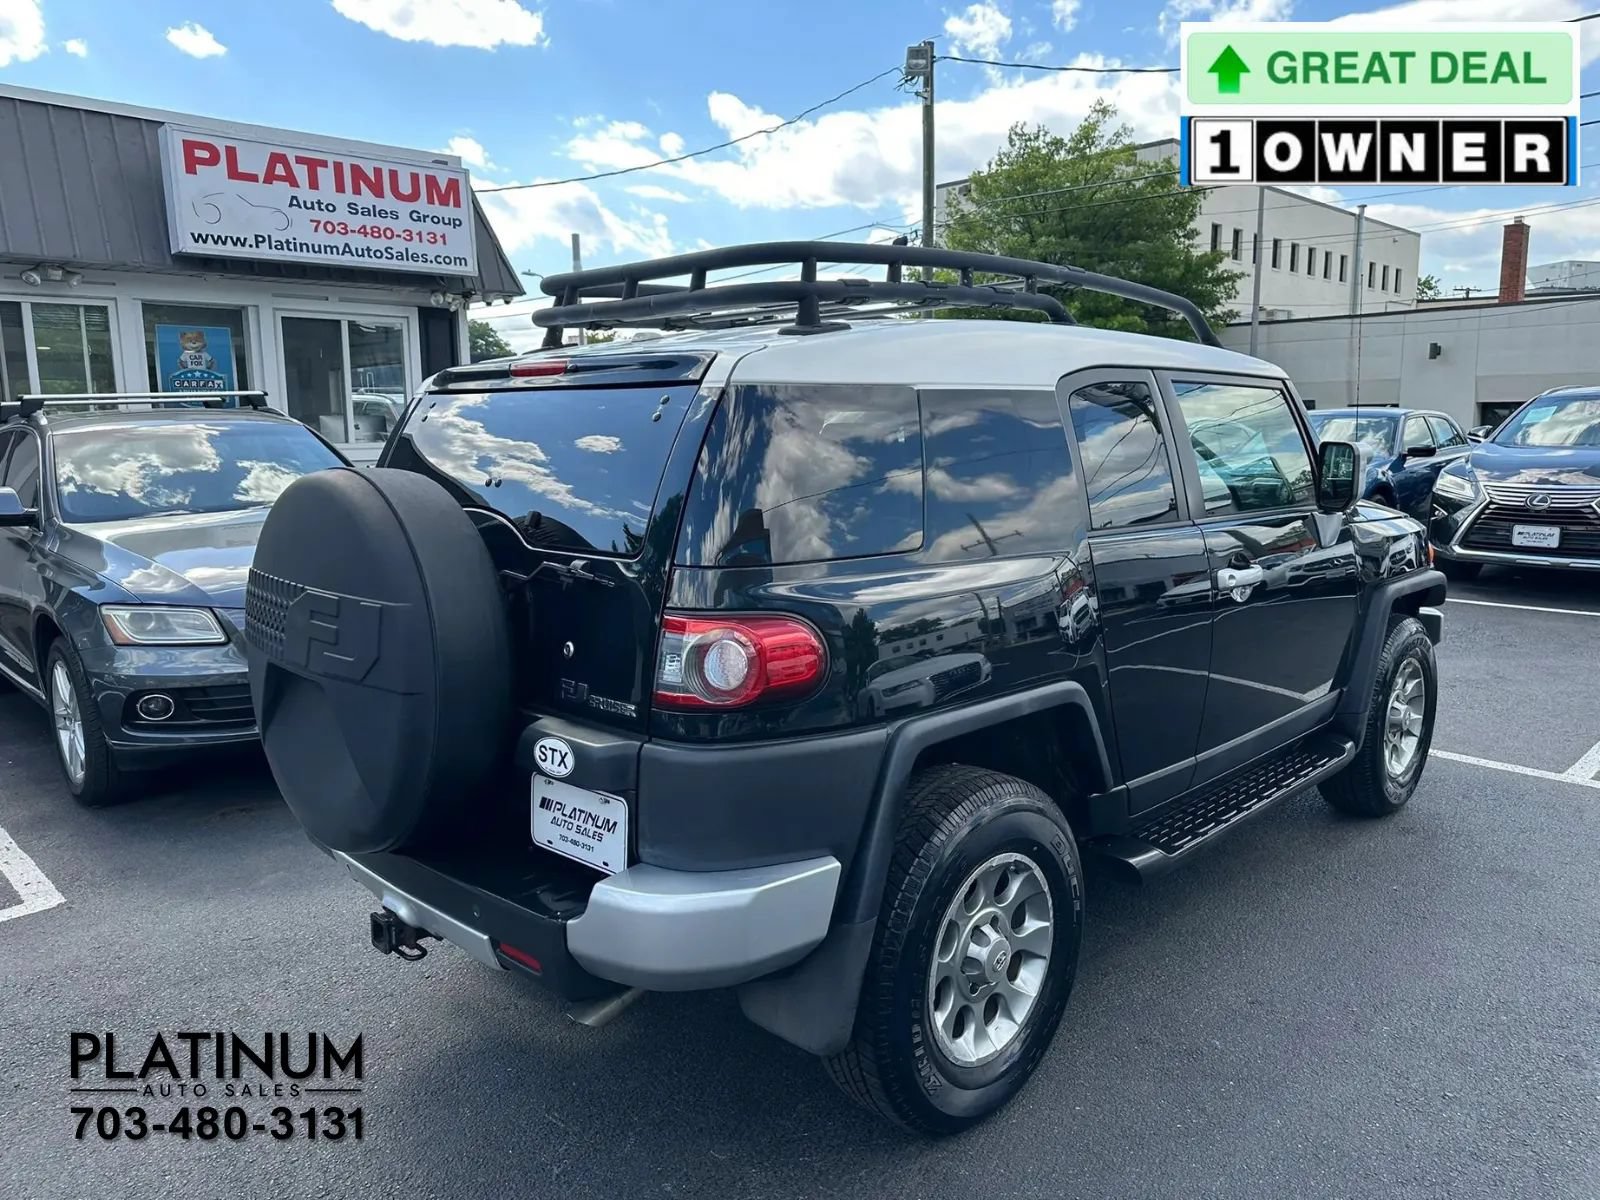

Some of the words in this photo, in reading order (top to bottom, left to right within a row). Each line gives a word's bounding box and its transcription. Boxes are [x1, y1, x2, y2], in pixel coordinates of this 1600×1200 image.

[182, 139, 462, 208] PLATINUM
[288, 195, 337, 213] Auto
[347, 202, 400, 220] Sales
[409, 210, 463, 229] Group
[309, 218, 448, 246] 703-480-3131
[190, 232, 468, 267] www.PlatinumAutoSales.com
[174, 380, 223, 389] CARFAX
[285, 590, 383, 682] FJ
[561, 678, 588, 701] FJ
[538, 744, 569, 770] STX
[550, 816, 574, 831] AUTO
[575, 824, 604, 842] SALES
[552, 800, 618, 834] PLATINUM
[558, 834, 595, 852] 703-480-3131
